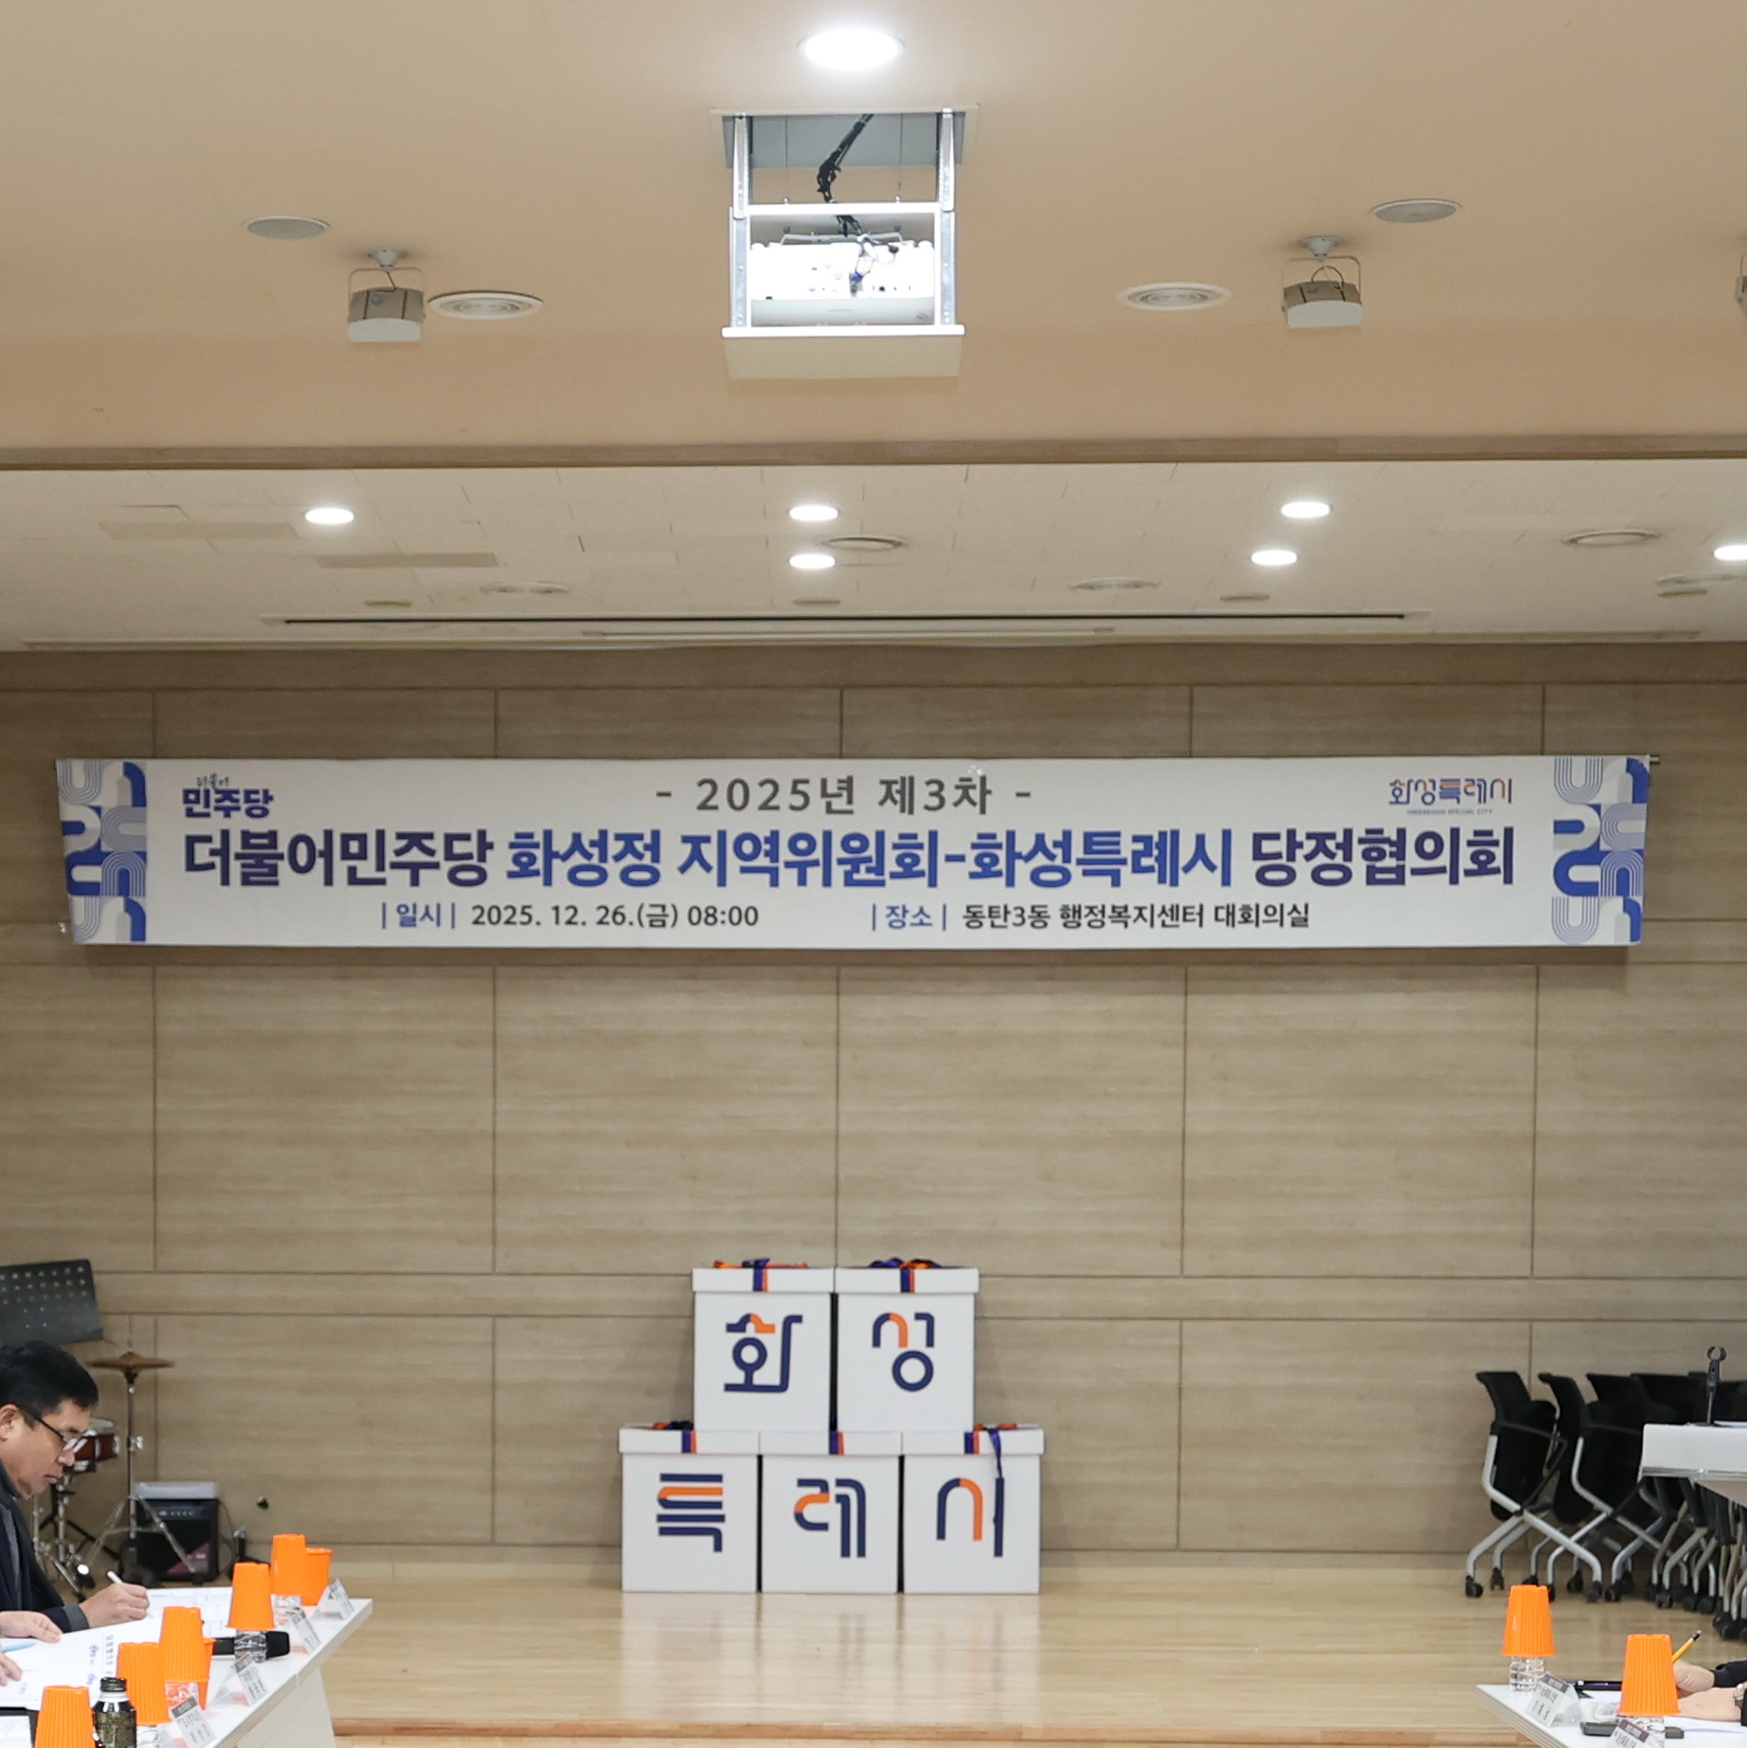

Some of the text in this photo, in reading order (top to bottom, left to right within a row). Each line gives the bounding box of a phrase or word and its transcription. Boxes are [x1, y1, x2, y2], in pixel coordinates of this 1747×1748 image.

[182, 788, 274, 819] 민주당
[696, 778, 855, 815] 2025년
[878, 774, 993, 816] 제3차
[1388, 778, 1513, 806] 화성특례시
[184, 826, 1515, 888] 더불어민주당 화성정 지역위원회-화성특례시 당정협의회
[471, 904, 541, 926] 2025.
[551, 904, 588, 926] 12.
[597, 903, 679, 928] 26.(금)
[687, 905, 760, 926] 08:00
[963, 904, 1051, 930] 동탄3동
[1060, 903, 1205, 929] 행정복지센터
[1214, 902, 1310, 928] 대회의실
[724, 1312, 934, 1393] 화 성
[656, 1473, 1005, 1558] 특 례 시
